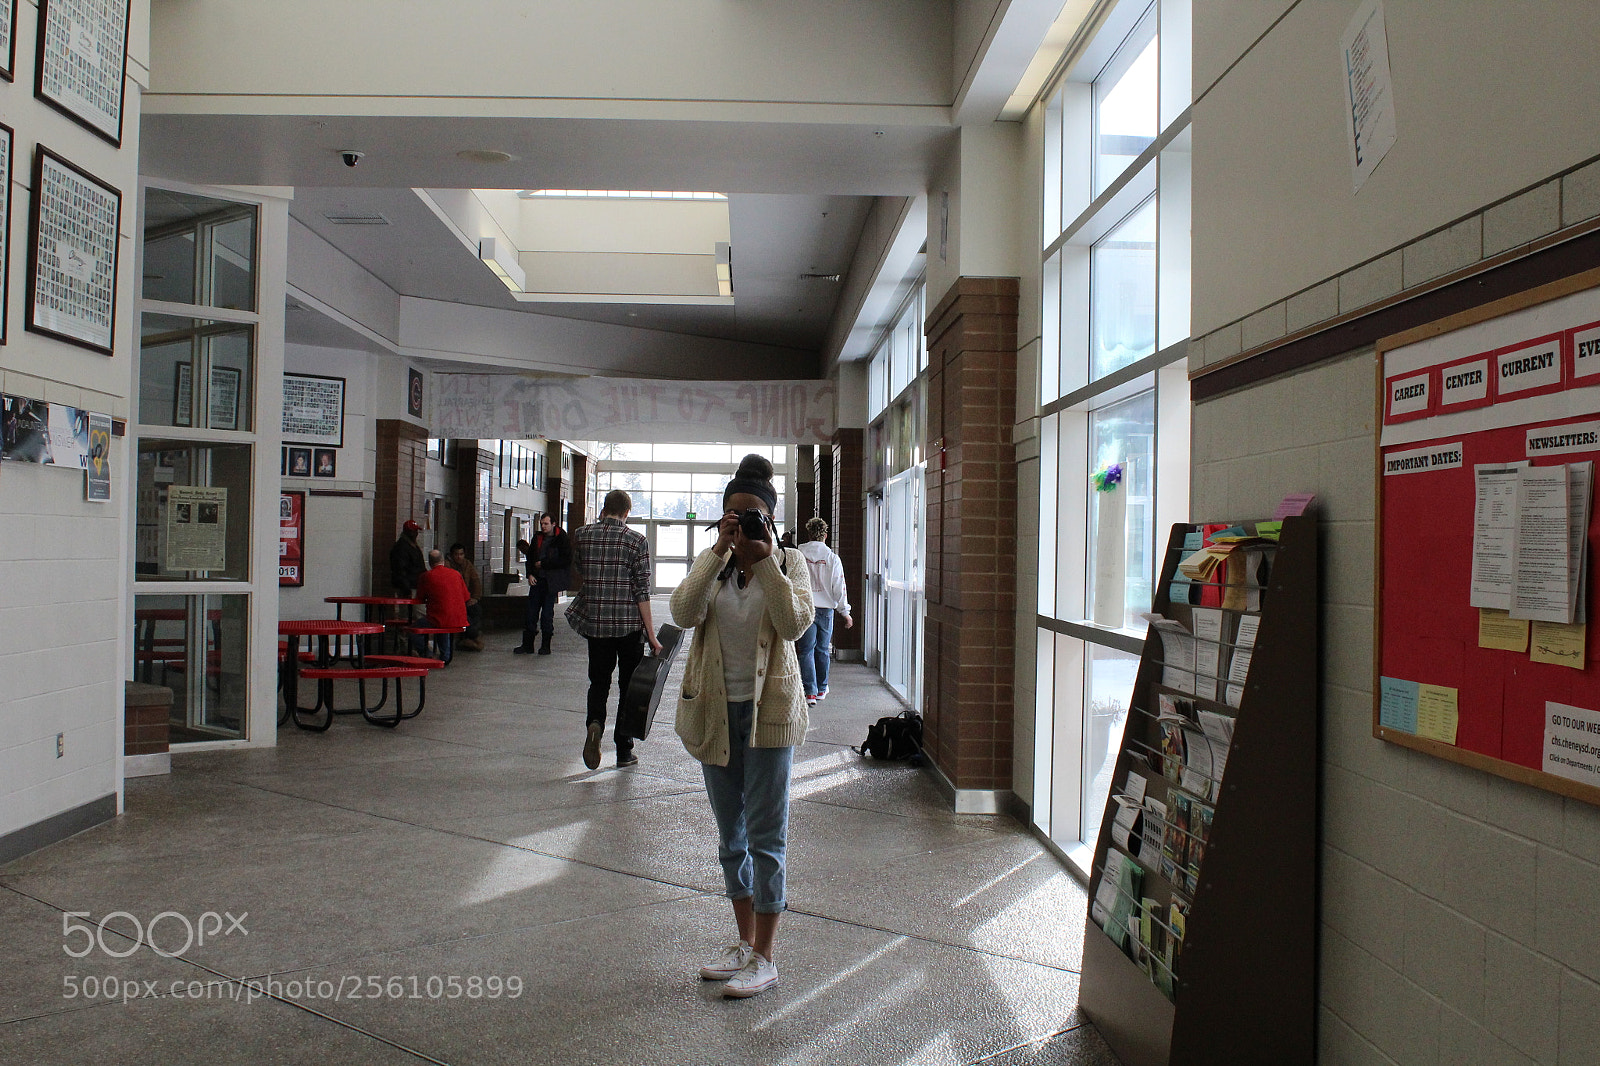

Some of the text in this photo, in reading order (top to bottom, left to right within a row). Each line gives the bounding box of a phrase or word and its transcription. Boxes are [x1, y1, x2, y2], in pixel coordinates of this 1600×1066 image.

[1394, 383, 1425, 402] CAREER
[1445, 369, 1483, 390] CENTER
[1501, 352, 1554, 378] CURRENT
[1529, 431, 1598, 450] NEWSLETTERS:
[1387, 450, 1462, 472] IMPORTANT DATES:
[1552, 714, 1562, 726] GO
[1562, 716, 1571, 728] TO
[1571, 719, 1585, 732] OUR
